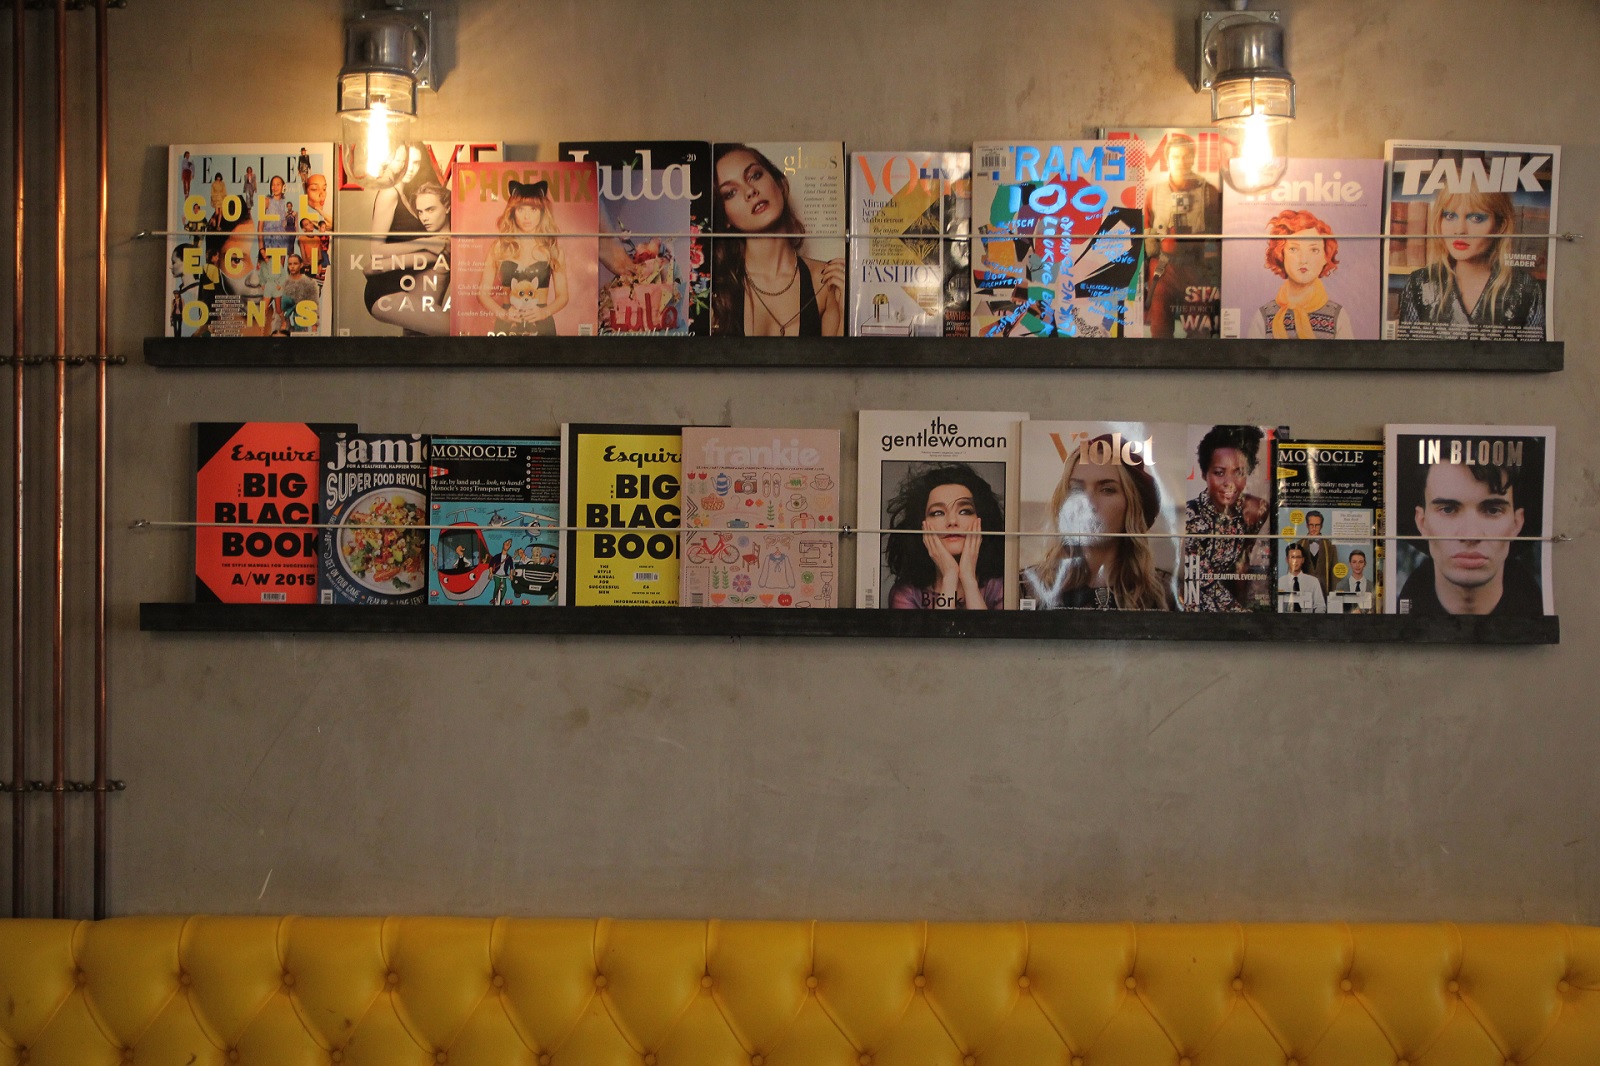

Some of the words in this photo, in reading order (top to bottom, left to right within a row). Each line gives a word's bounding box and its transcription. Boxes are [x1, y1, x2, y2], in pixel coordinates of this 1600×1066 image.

[202, 156, 297, 184] ELLE
[569, 149, 702, 201] ula
[1393, 154, 1553, 196] TANK
[183, 194, 319, 222] COLL
[862, 198, 898, 208] Miranda
[1008, 183, 1109, 215] 100
[183, 247, 318, 275] ECTI
[350, 254, 450, 270] KENDA
[1503, 252, 1537, 261] SUMMER
[1503, 260, 1536, 268] READER
[399, 274, 438, 292] ON
[182, 299, 319, 327] ONS
[930, 416, 959, 435] the
[327, 432, 427, 471] jami
[431, 444, 518, 459] MONOCLE
[701, 437, 821, 467] frankie
[881, 428, 1007, 452] gentlewoman
[1048, 431, 1157, 467] Violet
[1418, 438, 1441, 465] IN
[1450, 439, 1524, 467] BLOOM
[230, 444, 320, 467] Esquire
[1278, 449, 1364, 464] MONOCLE
[243, 472, 308, 498] BIG
[326, 472, 372, 510] SUPER
[372, 472, 395, 489] FOOD
[472, 485, 501, 494] Transport
[501, 485, 521, 494] Survey
[615, 473, 681, 500] BIG
[214, 502, 320, 528] BLAC
[593, 533, 680, 560] BOO
[231, 571, 270, 588] A/W
[275, 573, 316, 586] 2015
[1213, 573, 1240, 581] BEAUTIFUL
[920, 590, 964, 610] Björk
